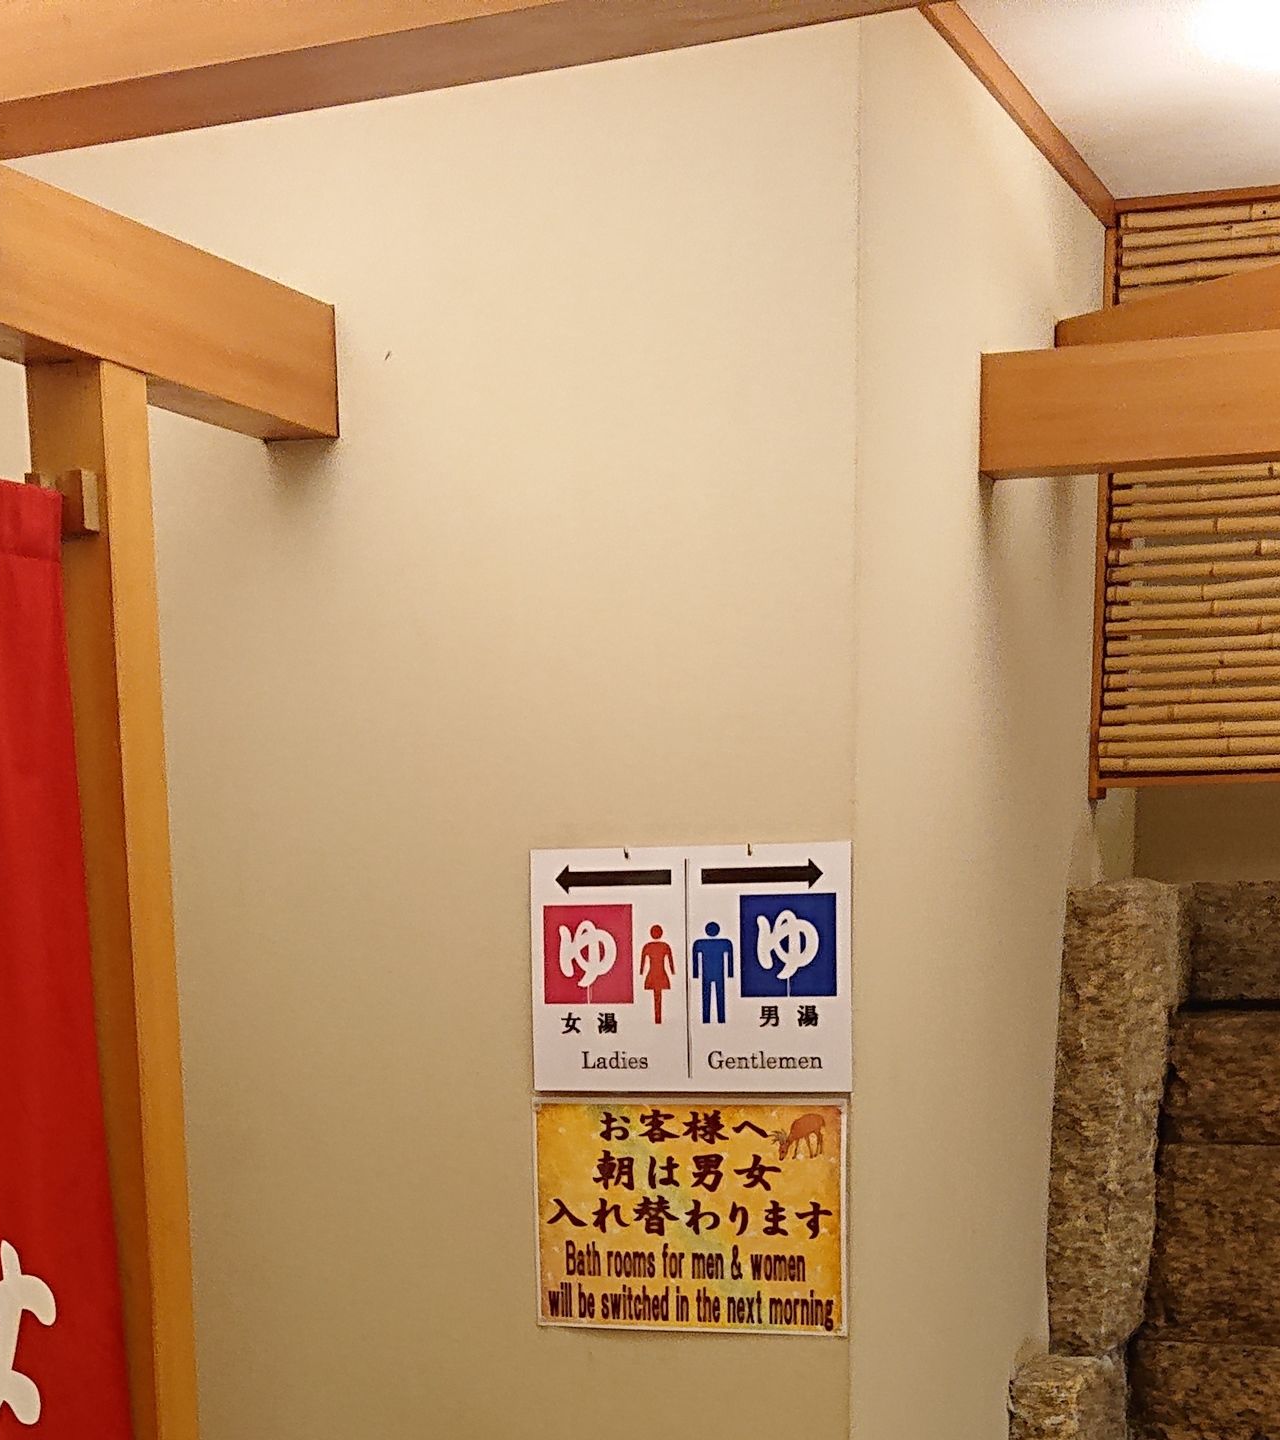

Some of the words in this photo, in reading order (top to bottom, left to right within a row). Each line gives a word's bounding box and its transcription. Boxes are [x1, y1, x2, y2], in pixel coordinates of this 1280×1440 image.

[559, 919, 618, 988] ゆ
[756, 909, 820, 980] ゆ
[581, 1051, 648, 1070] Ladies
[707, 1051, 823, 1070] Gentlemen
[599, 1109, 770, 1145] お客様へ
[592, 1150, 782, 1191] 朝は男女
[547, 1195, 833, 1239] 入れ替わります
[565, 1240, 602, 1276] Bath
[607, 1250, 656, 1279] rooms
[662, 1245, 684, 1279] for
[691, 1251, 724, 1280] men
[731, 1245, 743, 1280] &
[751, 1253, 806, 1282] women
[548, 1282, 572, 1318] will
[578, 1284, 595, 1318] be
[601, 1284, 669, 1322] switched
[676, 1287, 689, 1323] in
[696, 1287, 720, 1323] the
[727, 1291, 762, 1325] next
[769, 1289, 834, 1331] morning
